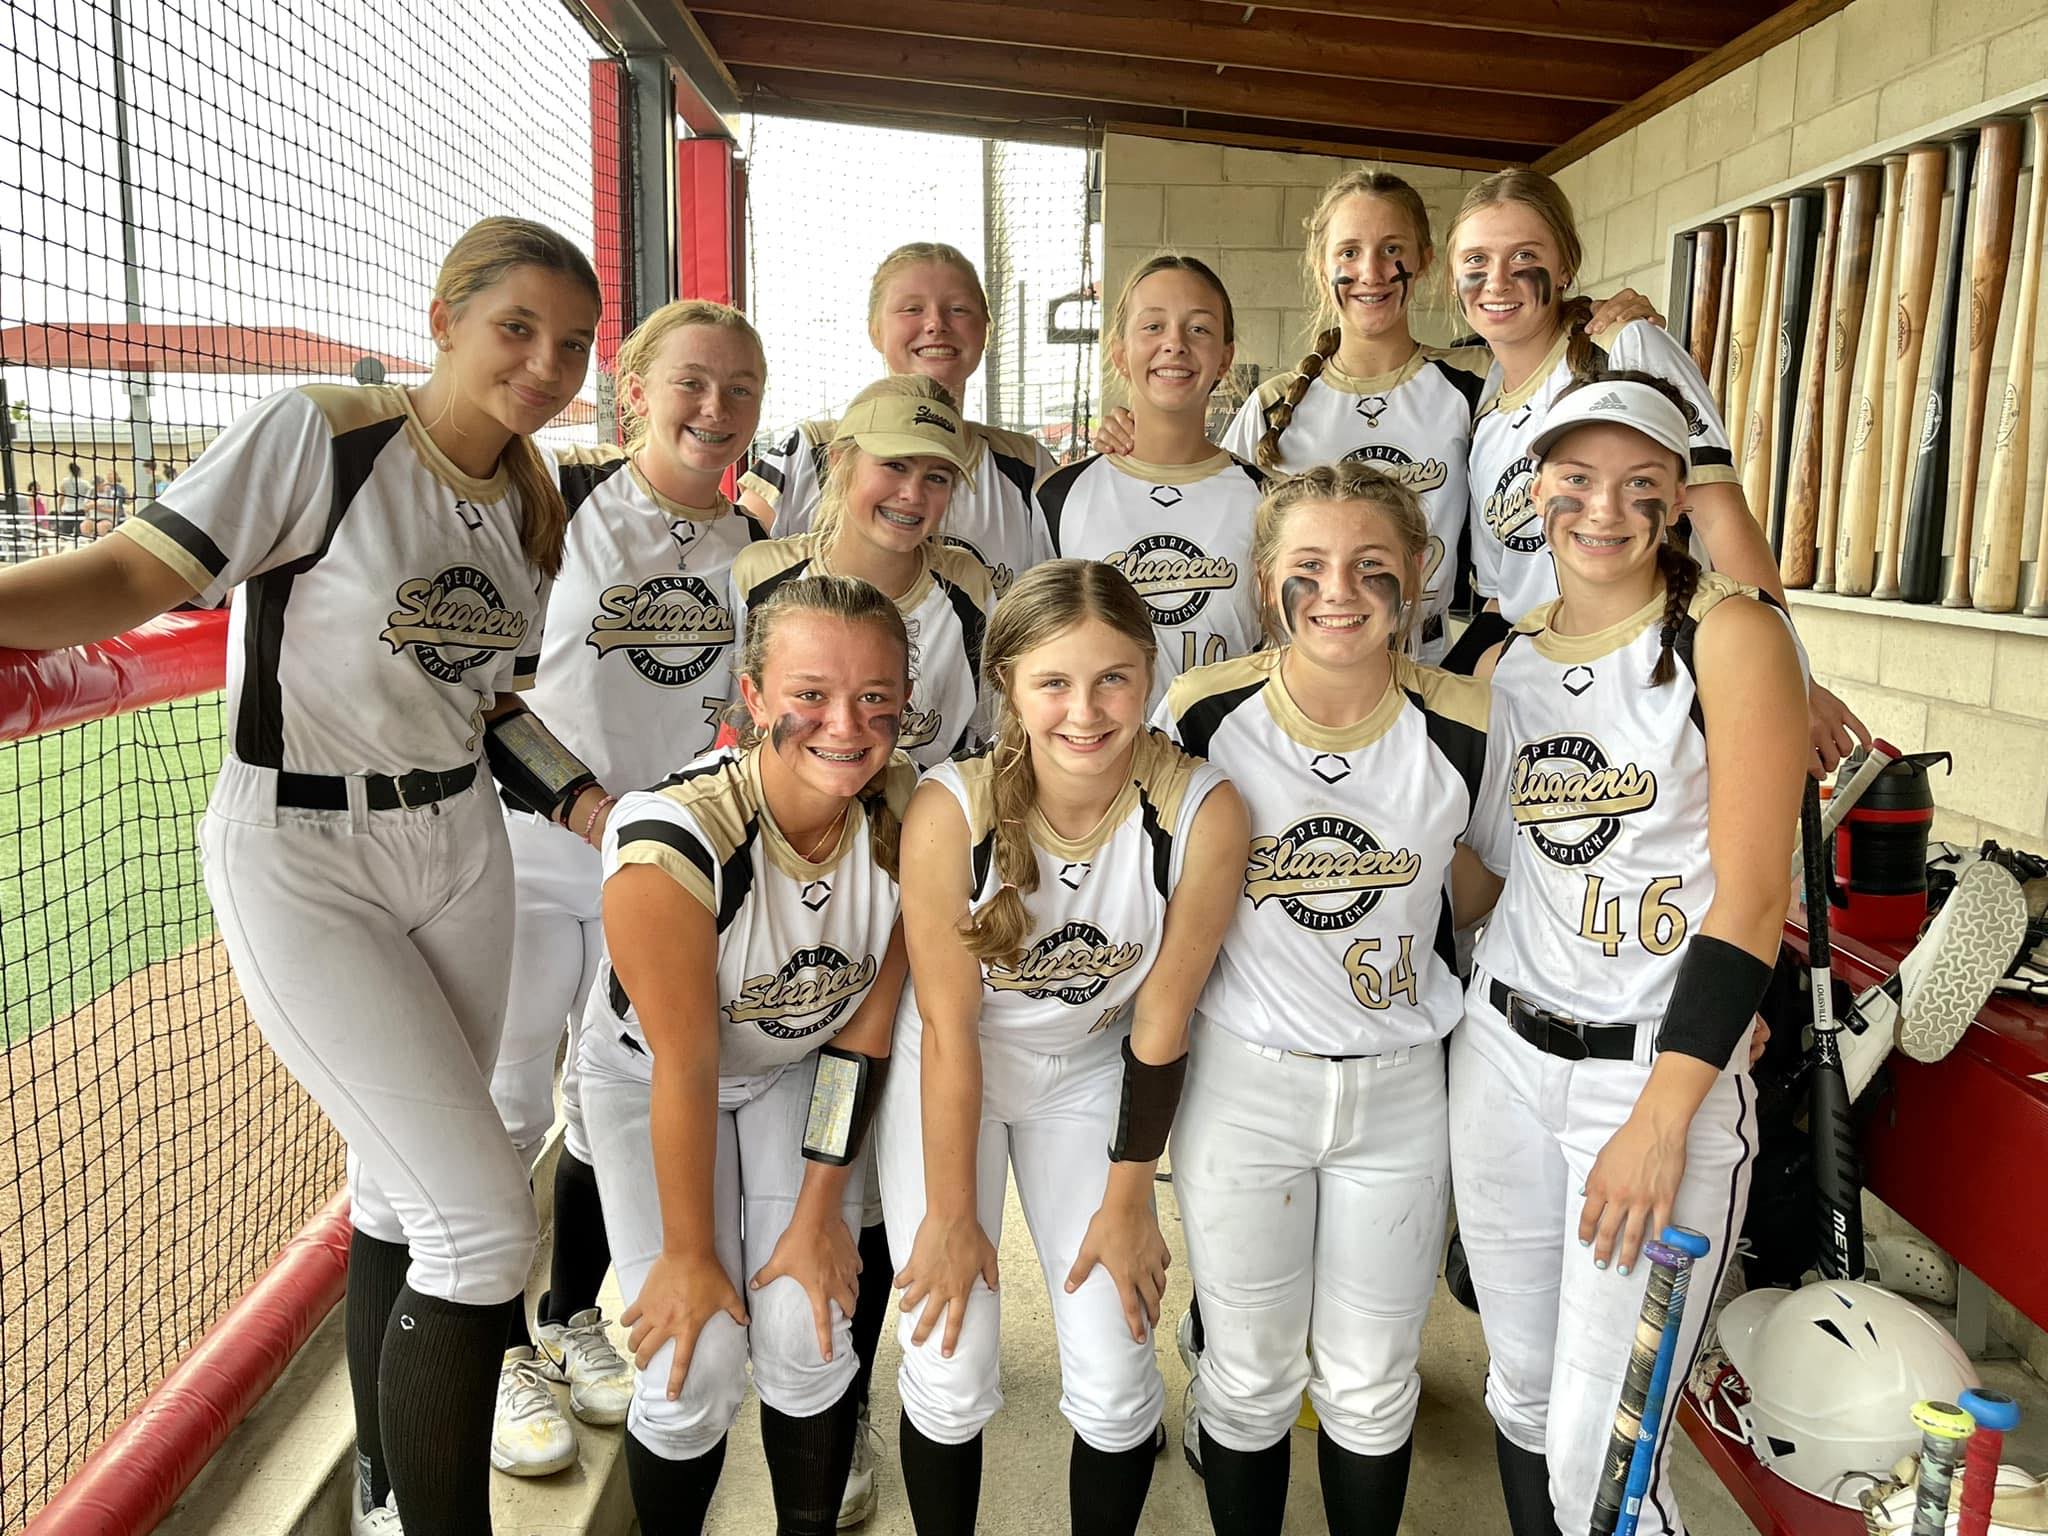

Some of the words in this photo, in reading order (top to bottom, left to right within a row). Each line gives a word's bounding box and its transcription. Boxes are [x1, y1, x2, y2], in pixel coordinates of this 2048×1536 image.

[1139, 536, 1194, 554] PEORIA
[444, 569, 495, 602] PEORIA
[650, 577, 706, 600] PEORIA
[1147, 581, 1185, 591] GOLD
[388, 577, 527, 637] Sluggers
[1149, 602, 1198, 623] STPITCH
[654, 633, 700, 642] GOLD
[633, 649, 706, 683] FASTPITCH
[1531, 739, 1596, 766] PEORIA
[1514, 756, 1656, 804] luggers
[1542, 804, 1587, 816] GOLD
[1296, 820, 1364, 845] PEORIA
[1244, 836, 1421, 882] Sluggers
[1301, 879, 1350, 889] GOLD
[1286, 899, 1365, 928] FASTPITCH
[1577, 874, 1688, 958] 46
[1343, 935, 1418, 1010] 64
[1816, 983, 1828, 1024] LOUISVILLE
